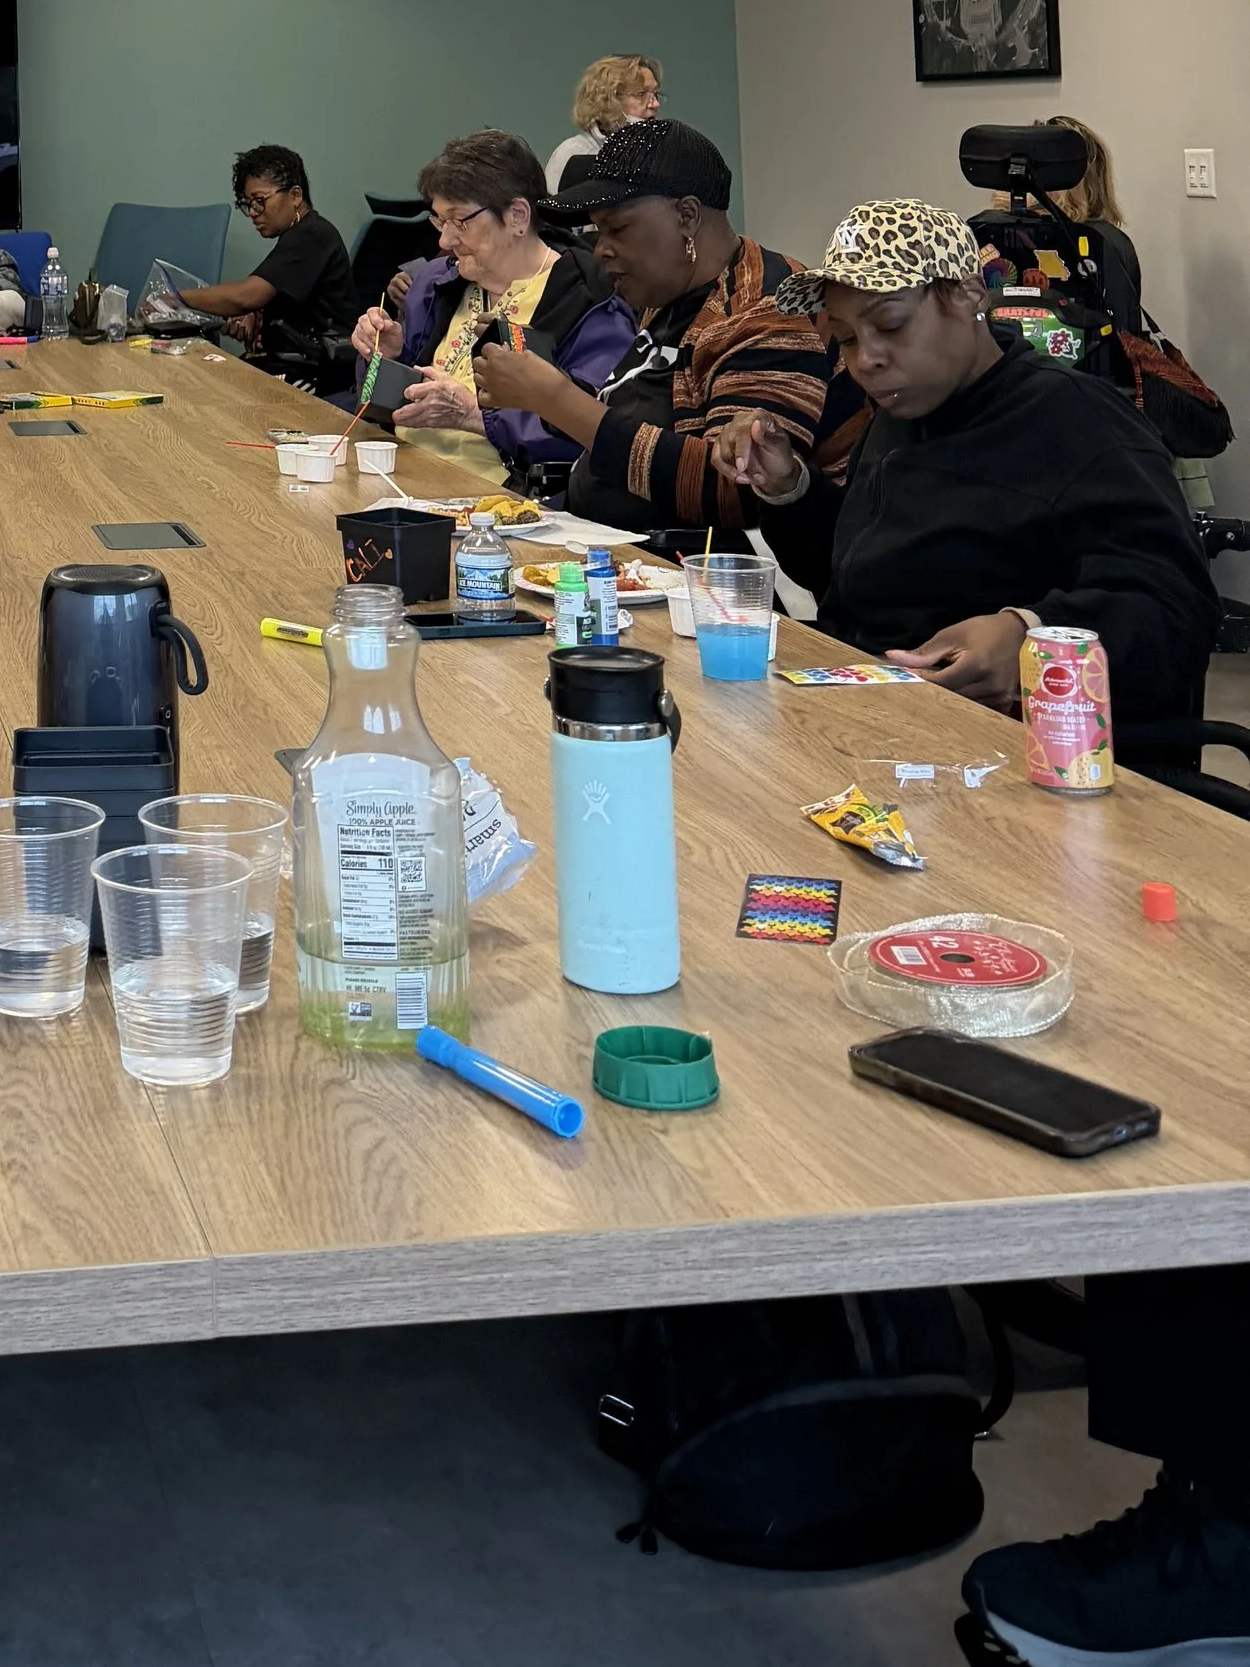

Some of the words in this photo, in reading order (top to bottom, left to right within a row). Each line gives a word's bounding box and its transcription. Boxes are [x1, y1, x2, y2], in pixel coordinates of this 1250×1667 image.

[467, 580, 502, 591] MOUNTAIN
[1028, 696, 1097, 715] Grapefruit
[346, 800, 382, 818] Simply
[340, 827, 370, 836] Nutrition
[371, 827, 391, 837] Facts
[340, 858, 367, 868] Calories
[378, 858, 393, 868] 110
